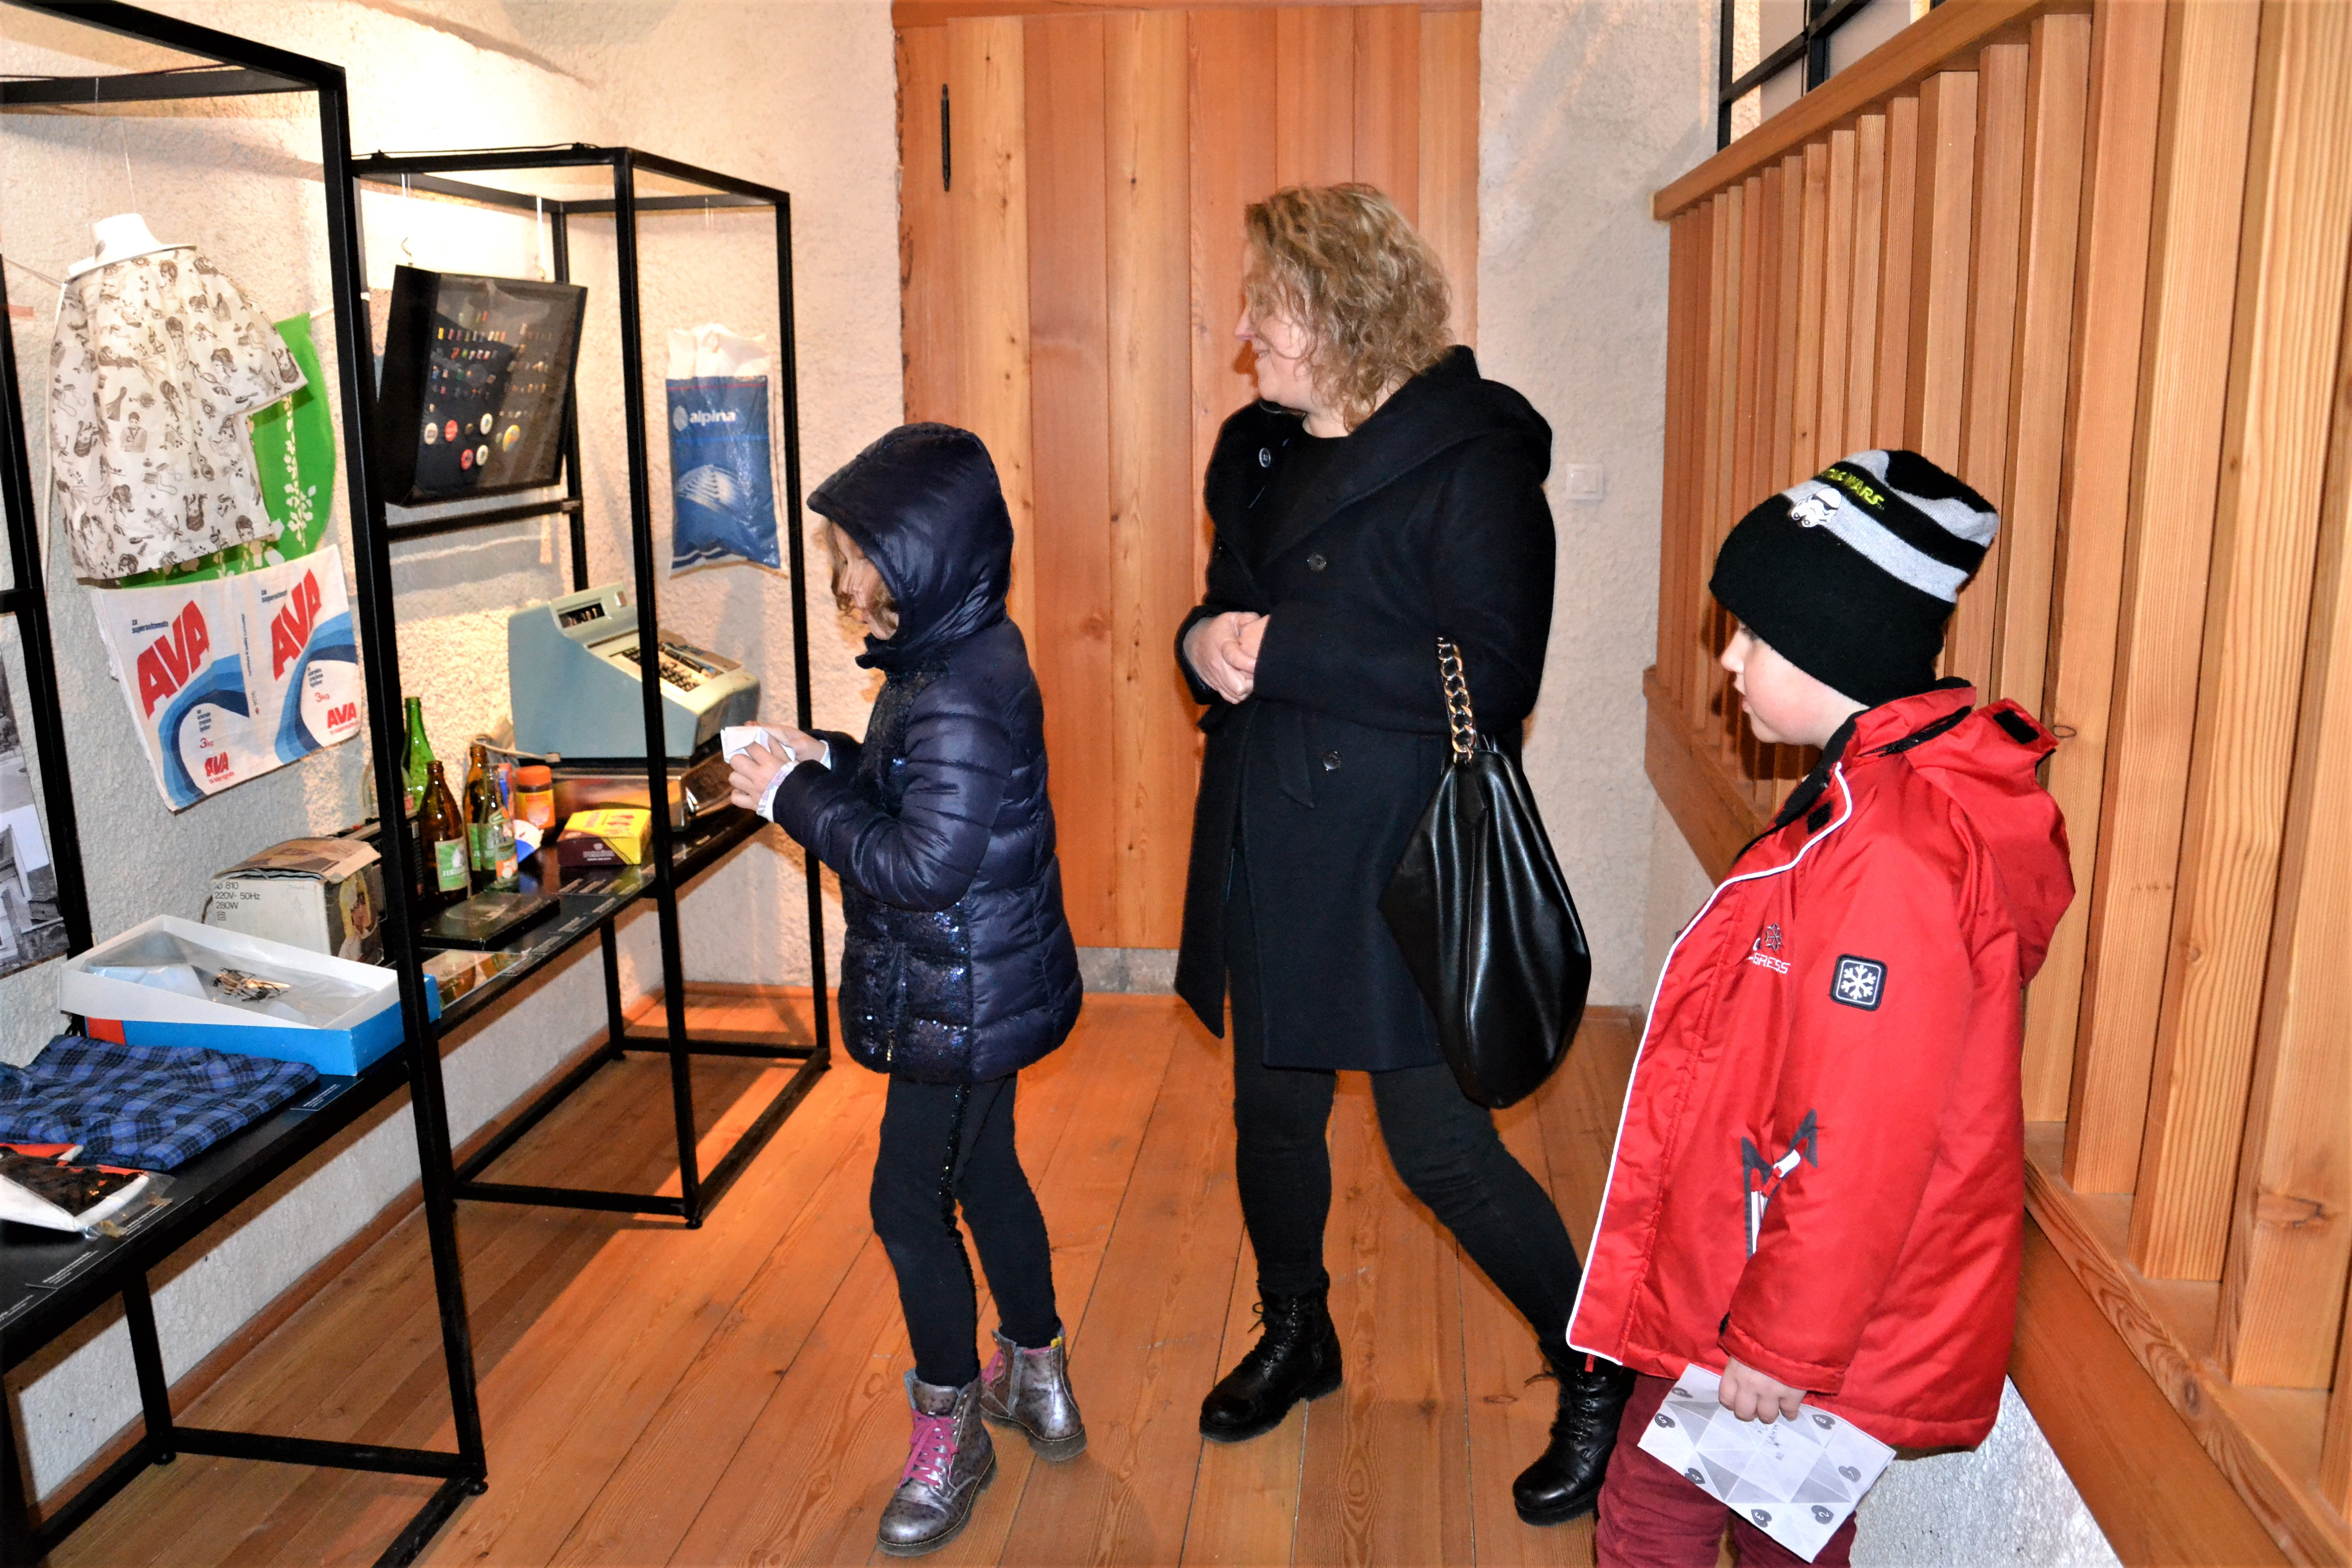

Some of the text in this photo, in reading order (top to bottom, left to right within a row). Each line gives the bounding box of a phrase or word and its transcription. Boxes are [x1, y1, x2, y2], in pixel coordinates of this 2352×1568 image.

[690, 410, 737, 427] alpina
[1844, 473, 1884, 505] WARS
[271, 568, 322, 681] AVA
[137, 600, 210, 721] AVA
[327, 702, 357, 729] AVA
[204, 751, 229, 777] AVA
[225, 881, 239, 890] 810
[240, 892, 261, 900] 50Hz
[1748, 952, 1791, 974] GRESS
